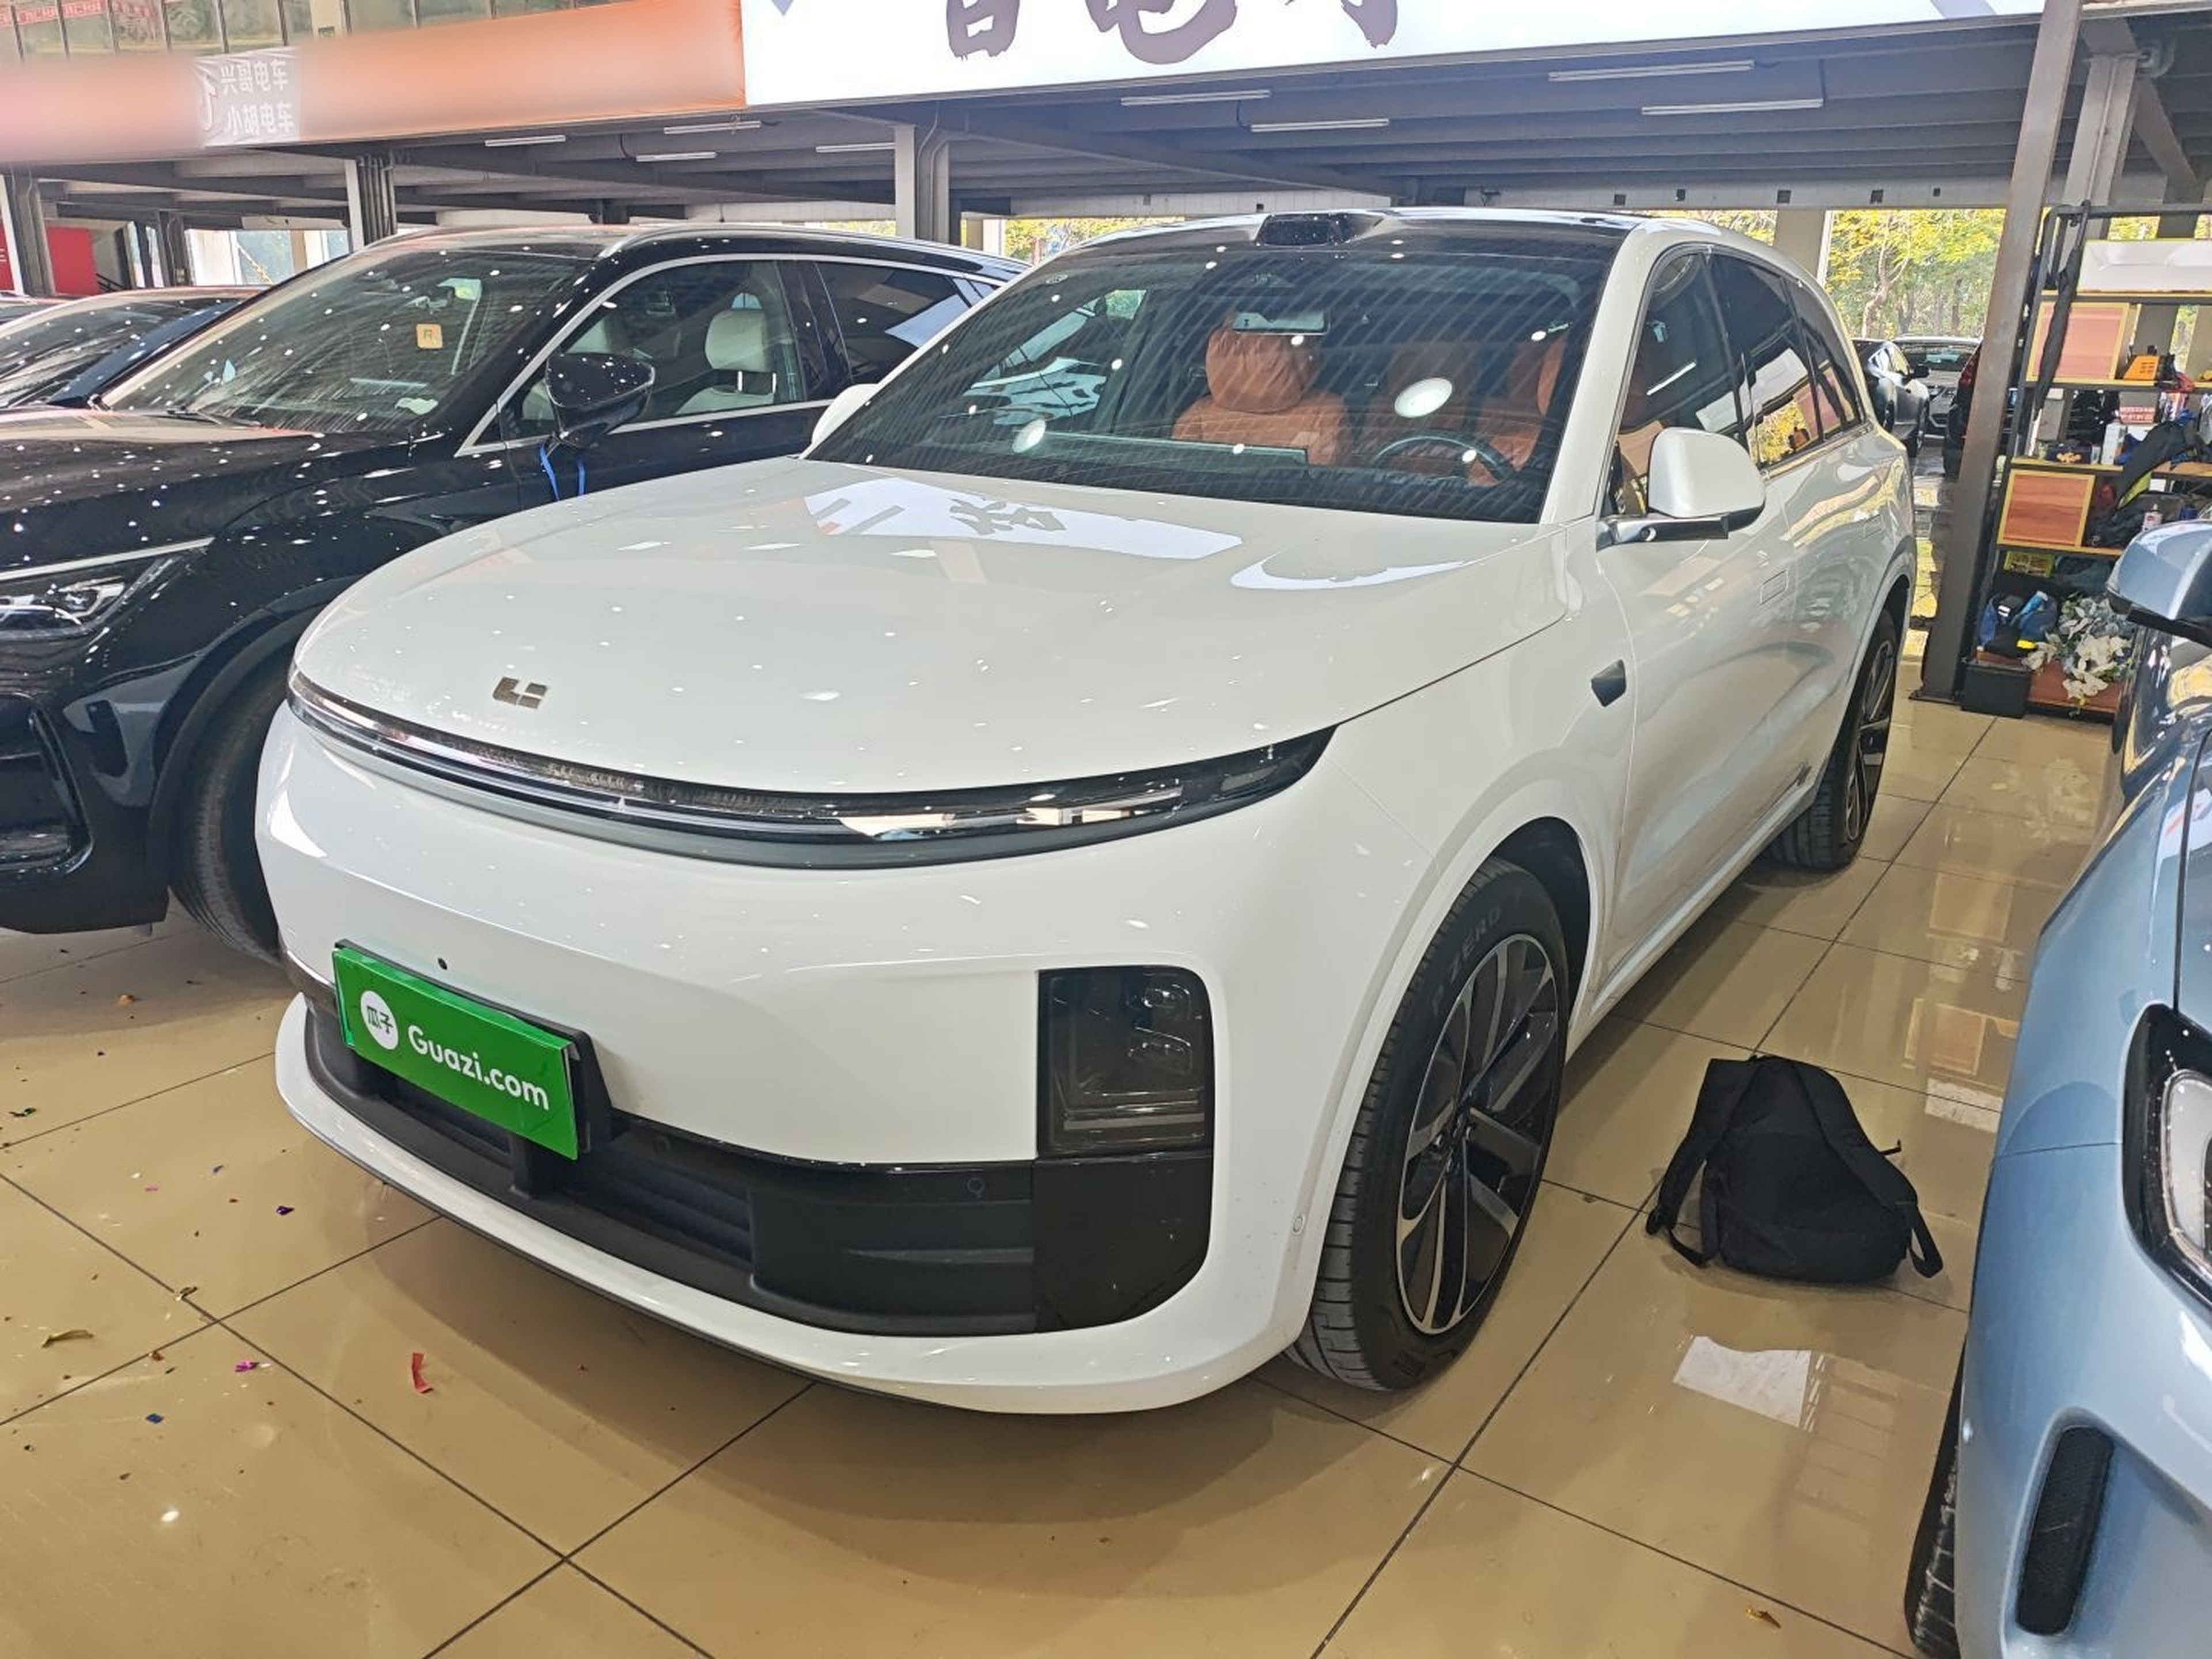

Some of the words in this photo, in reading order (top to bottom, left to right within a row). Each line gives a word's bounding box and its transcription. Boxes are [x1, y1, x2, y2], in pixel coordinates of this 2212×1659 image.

[221, 59, 288, 95] 兴哥电车
[366, 1005, 393, 1035] 瓜子
[407, 1025, 550, 1111] Guazi.com
